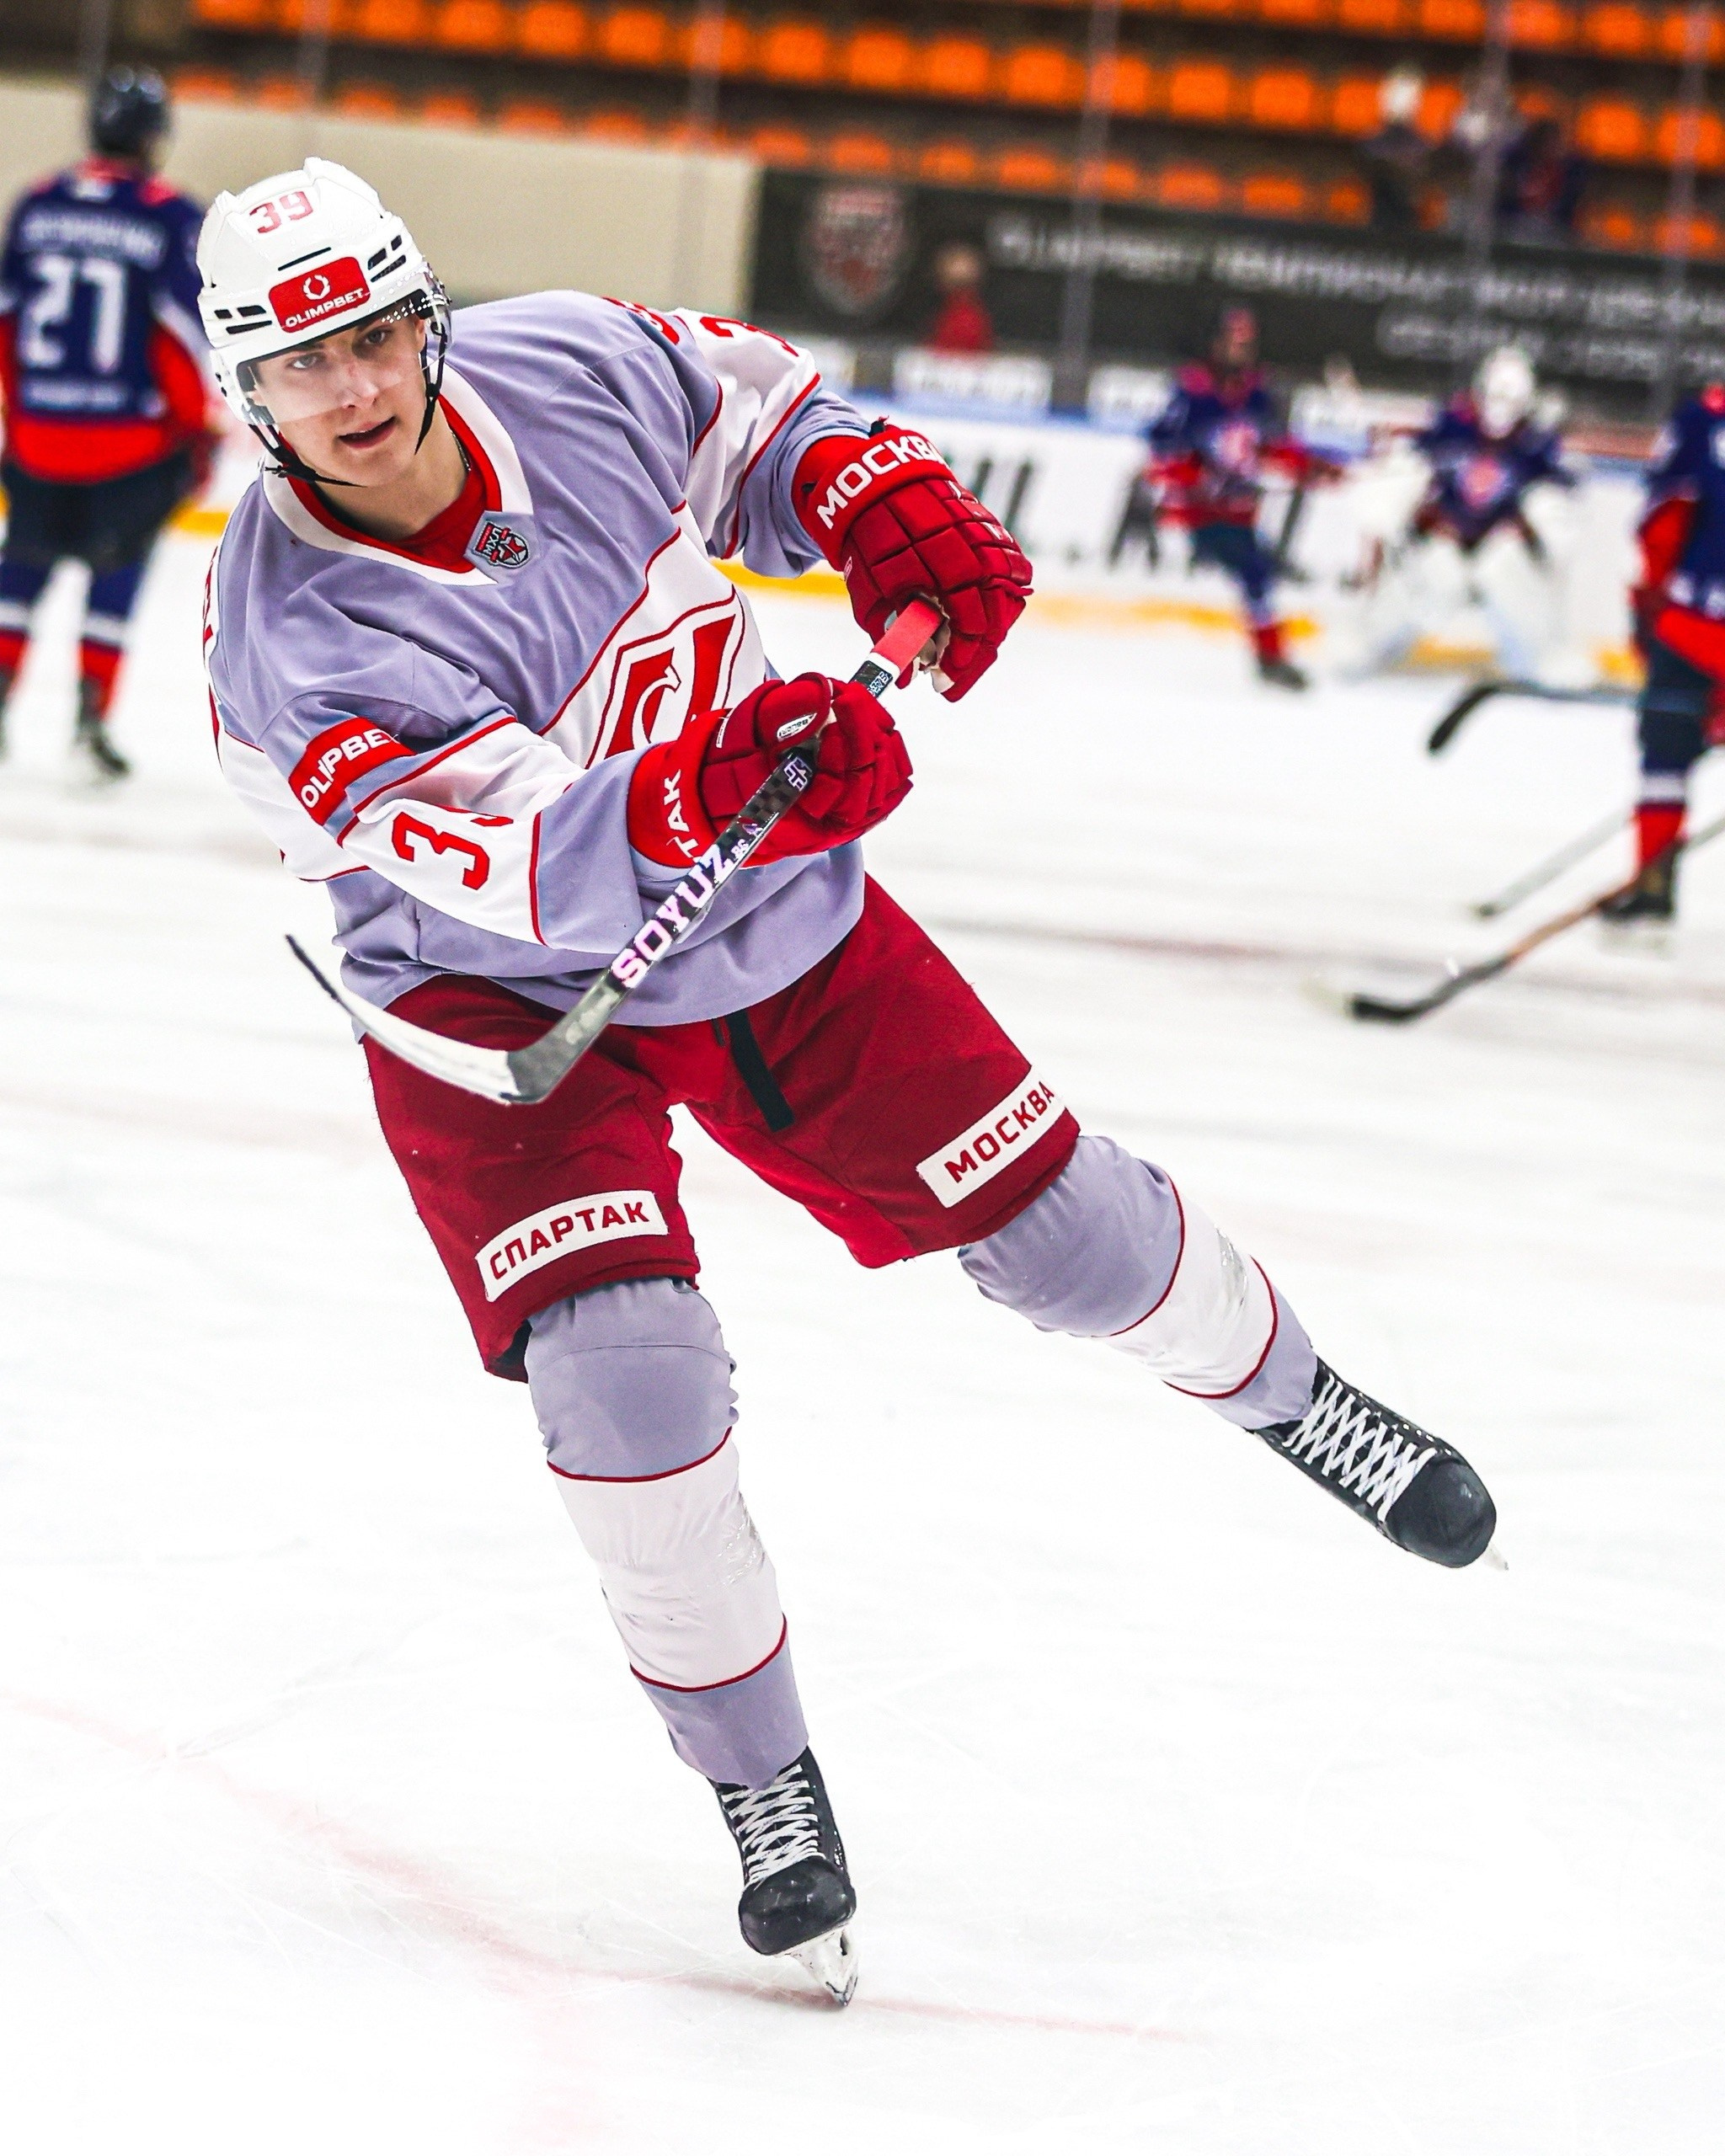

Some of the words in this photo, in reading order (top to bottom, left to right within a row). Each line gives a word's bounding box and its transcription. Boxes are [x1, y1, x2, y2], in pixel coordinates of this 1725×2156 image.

[249, 190, 314, 234] 39
[28, 253, 125, 373] 27
[285, 287, 365, 328] OLIMPBET
[483, 526, 504, 556] МХЛ
[301, 728, 391, 808] OLIPBE
[392, 804, 515, 891] 3
[664, 768, 700, 859] ТАК
[610, 843, 734, 989] SOYUZ
[943, 1081, 1055, 1184] МОСКВА
[489, 1201, 650, 1280] СПАРТАК
